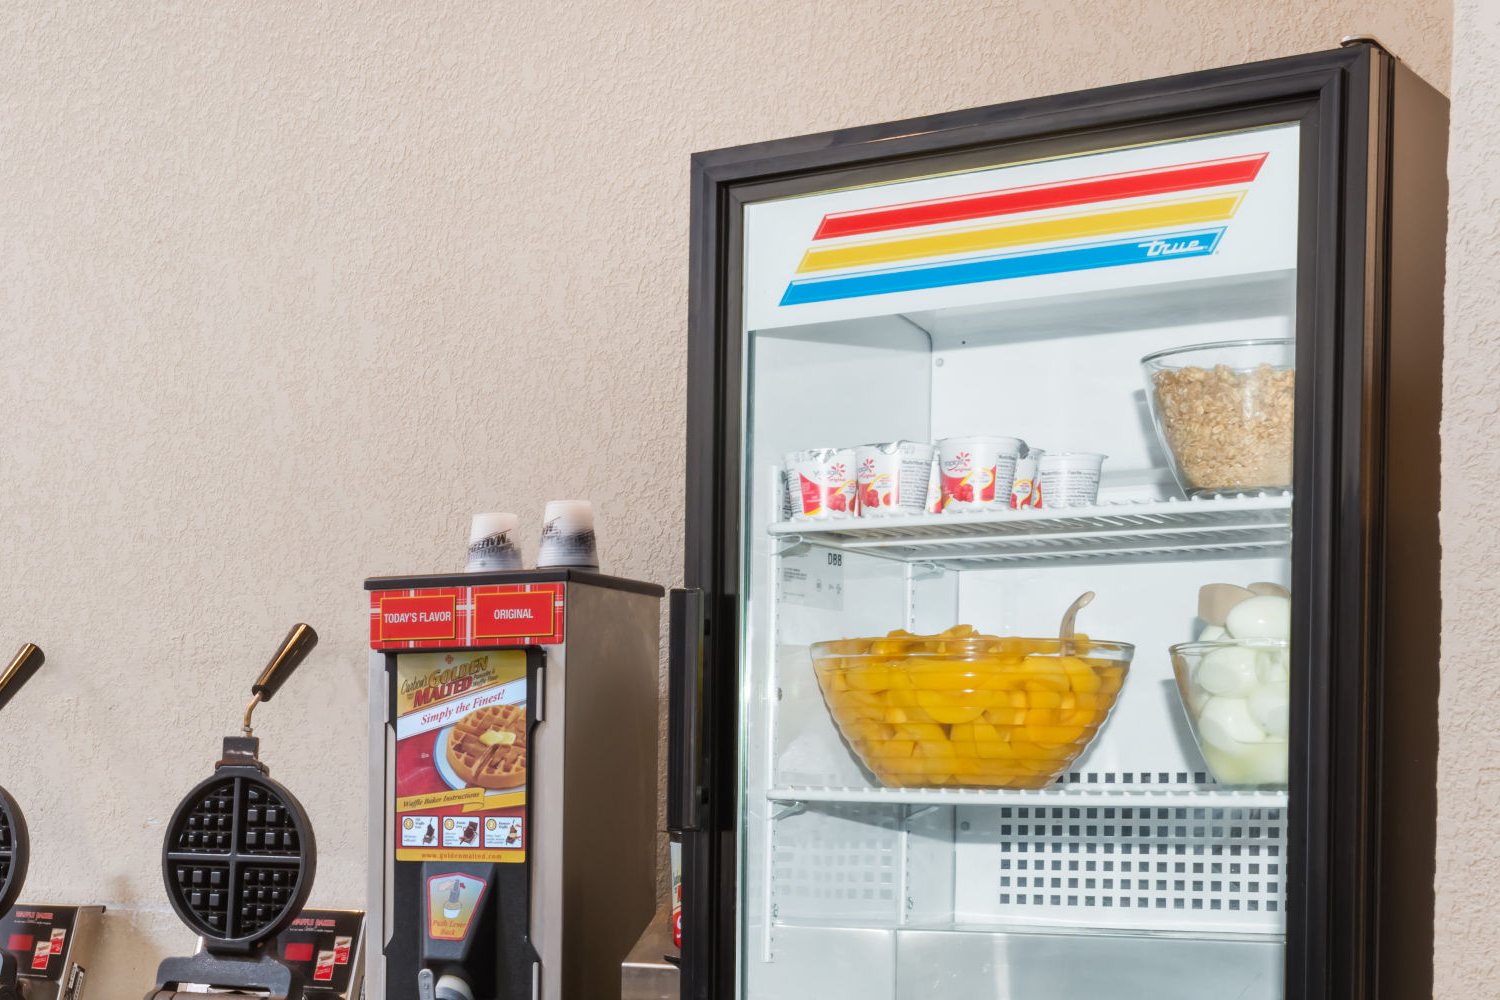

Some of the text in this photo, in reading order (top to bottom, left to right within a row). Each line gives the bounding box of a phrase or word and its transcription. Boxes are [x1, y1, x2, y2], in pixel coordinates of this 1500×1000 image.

[384, 611, 451, 623] TODAY'S FLAVOR
[494, 608, 534, 620] ORIGINAL
[429, 656, 488, 688] GOLDEN
[414, 676, 473, 708] MALTED
[421, 689, 505, 726] Simply the Finest!
[403, 799, 423, 808] Waffle
[443, 792, 480, 802] Instructions
